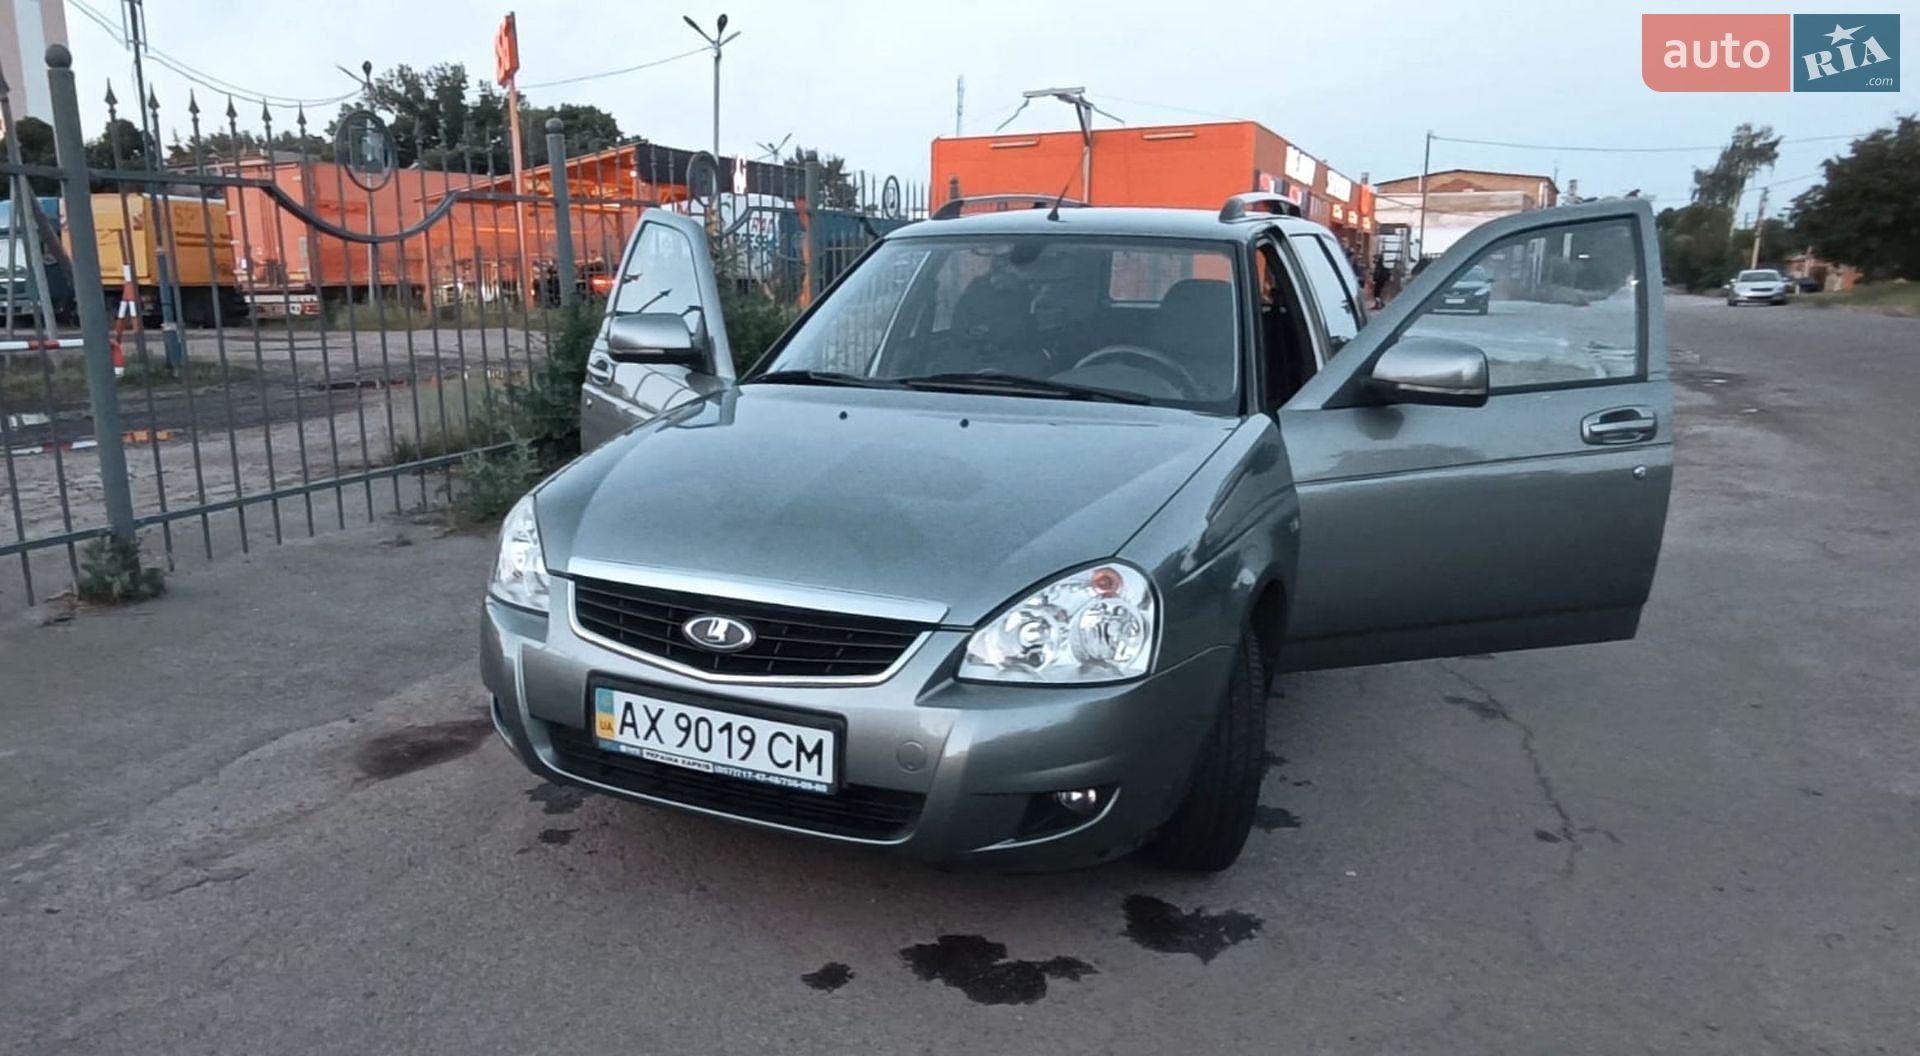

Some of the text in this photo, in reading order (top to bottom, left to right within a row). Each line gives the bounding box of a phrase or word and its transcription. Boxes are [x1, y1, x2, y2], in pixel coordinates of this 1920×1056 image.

[599, 719, 614, 732] UA
[618, 701, 826, 776] AX 9019 CM
